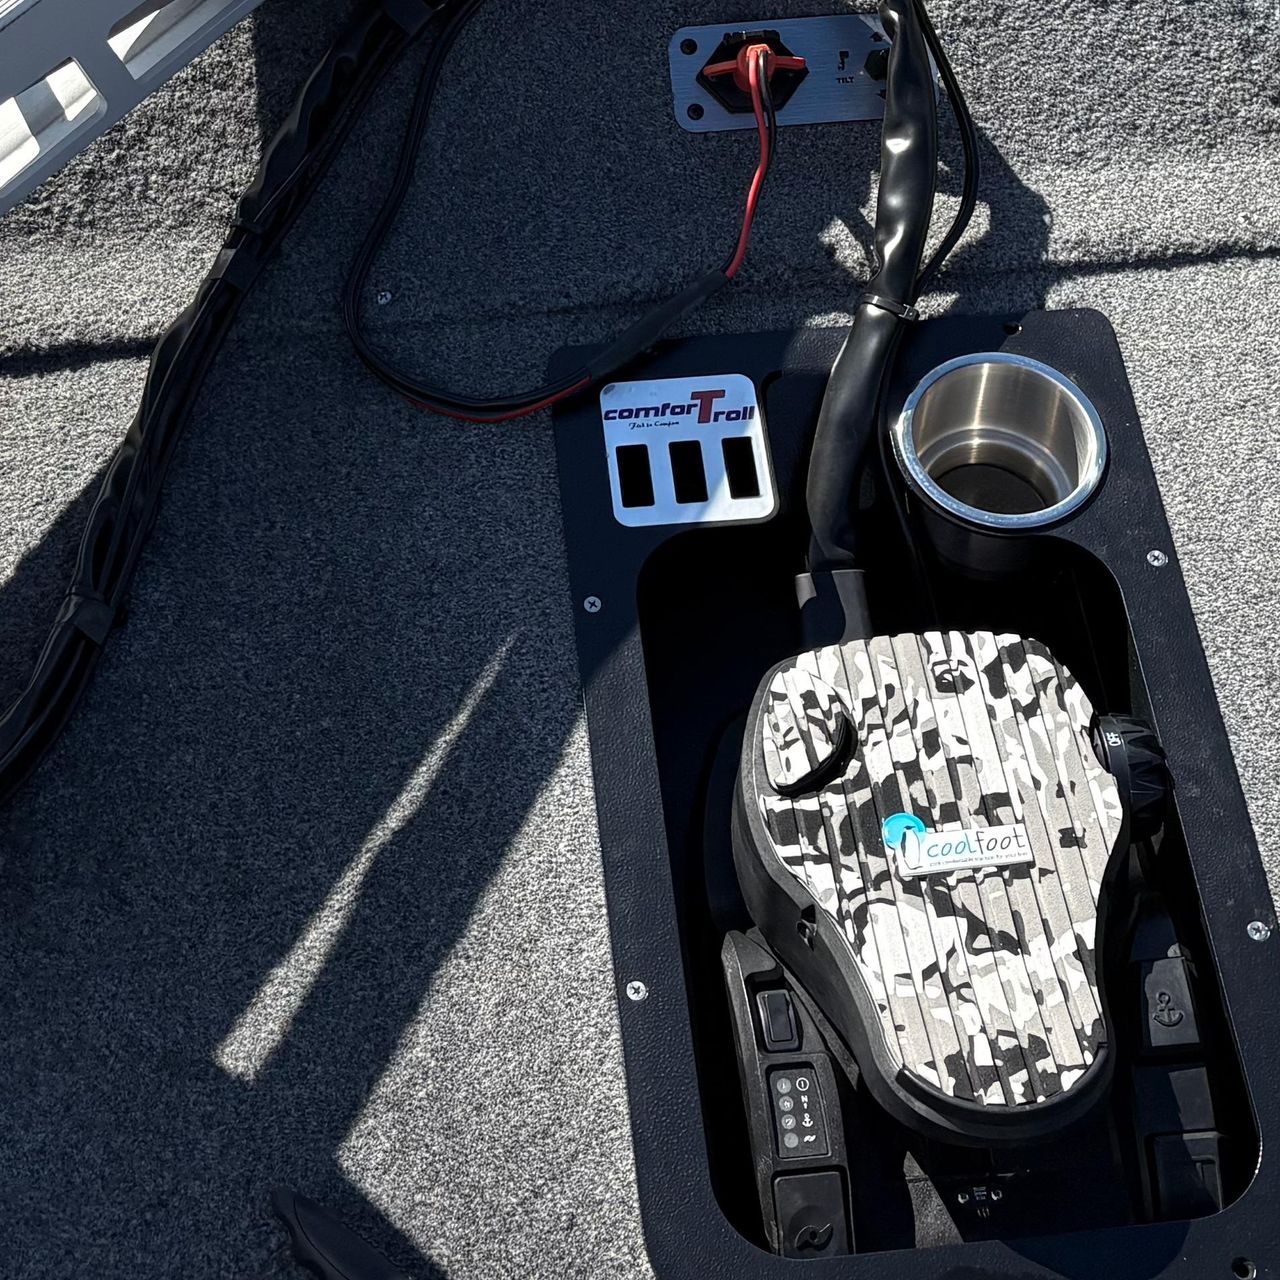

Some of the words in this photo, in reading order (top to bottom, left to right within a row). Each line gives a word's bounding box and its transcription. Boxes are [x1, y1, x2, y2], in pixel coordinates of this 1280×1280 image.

[836, 76, 854, 84] TILT
[1105, 732, 1122, 747] OFF
[927, 827, 1026, 858] coolfoot
